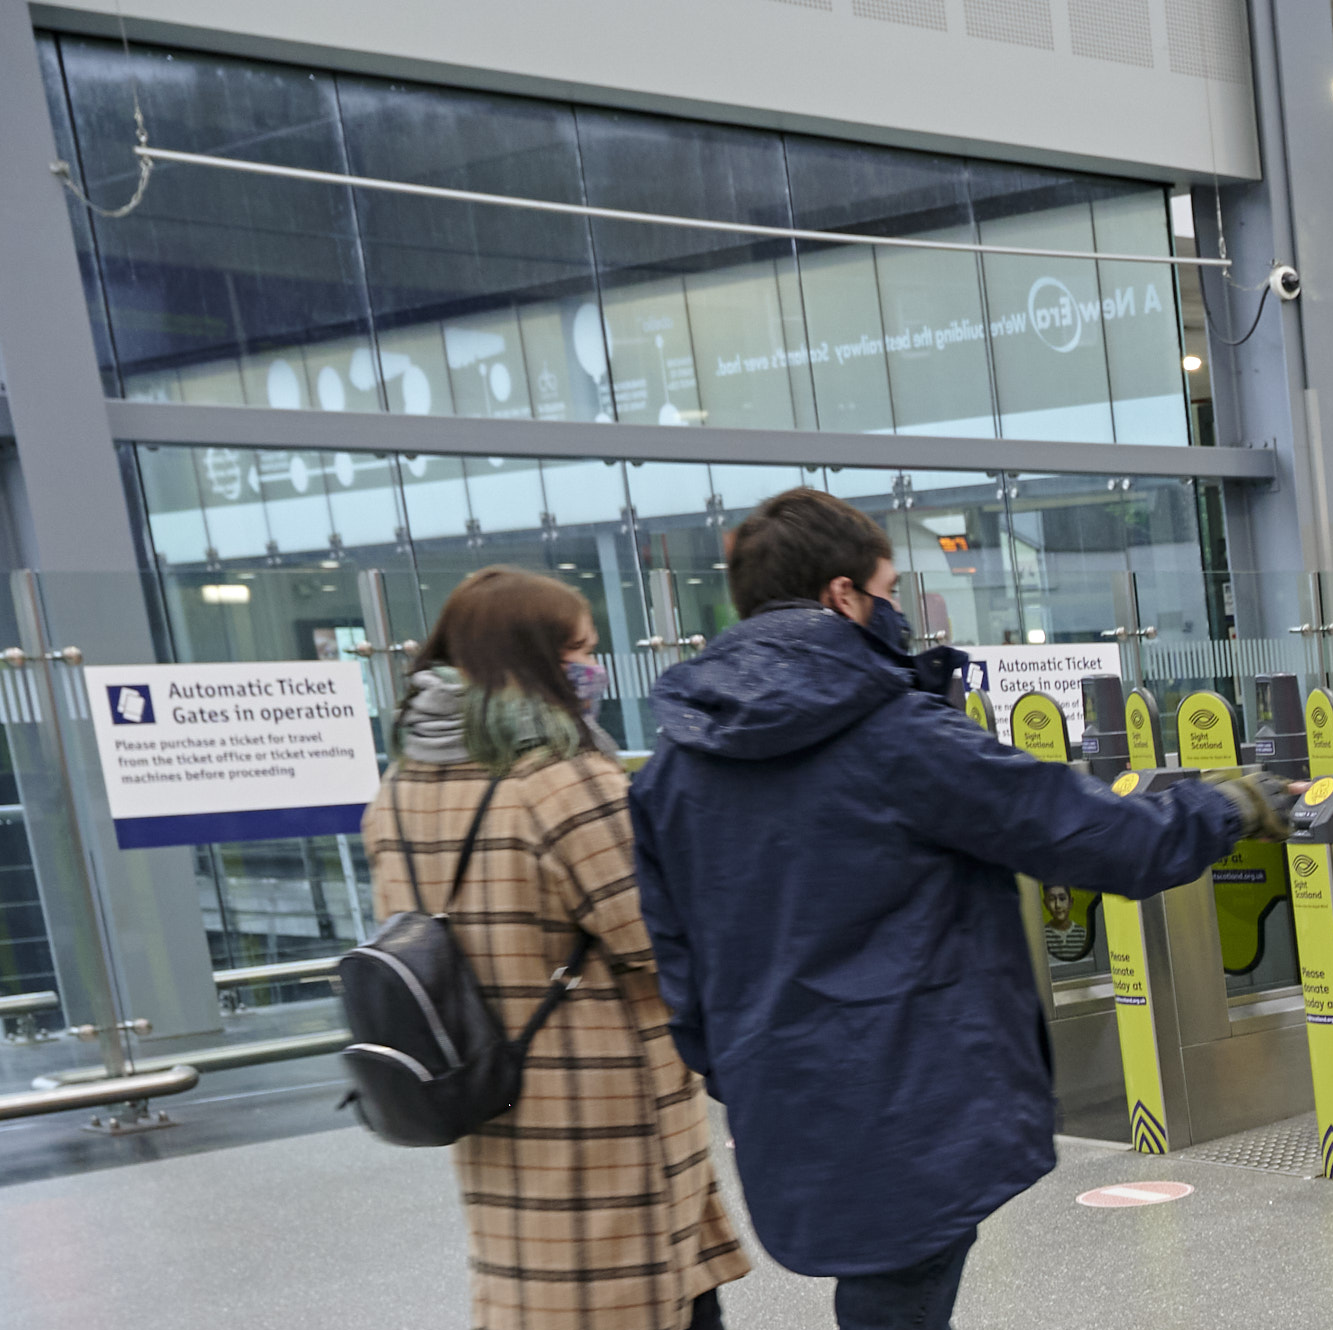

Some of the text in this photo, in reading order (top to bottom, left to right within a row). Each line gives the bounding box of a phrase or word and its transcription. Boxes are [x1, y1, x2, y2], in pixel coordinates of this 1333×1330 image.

[998, 657, 1103, 673] Automatic Ticket
[168, 678, 337, 700] Automatic Ticket
[1000, 678, 1051, 693] Gates in
[173, 700, 355, 725] Gates in operation
[115, 739, 158, 751] Please
[159, 736, 216, 753] purchase
[229, 734, 266, 746] ticket
[267, 733, 285, 745] for
[287, 731, 323, 743] travel
[1190, 732, 1209, 743] Sight
[1191, 741, 1223, 750] Scotland
[117, 746, 356, 768] from the ticket office or ticket vending
[121, 765, 296, 785] machines before proceeding
[1132, 982, 1142, 991] at
